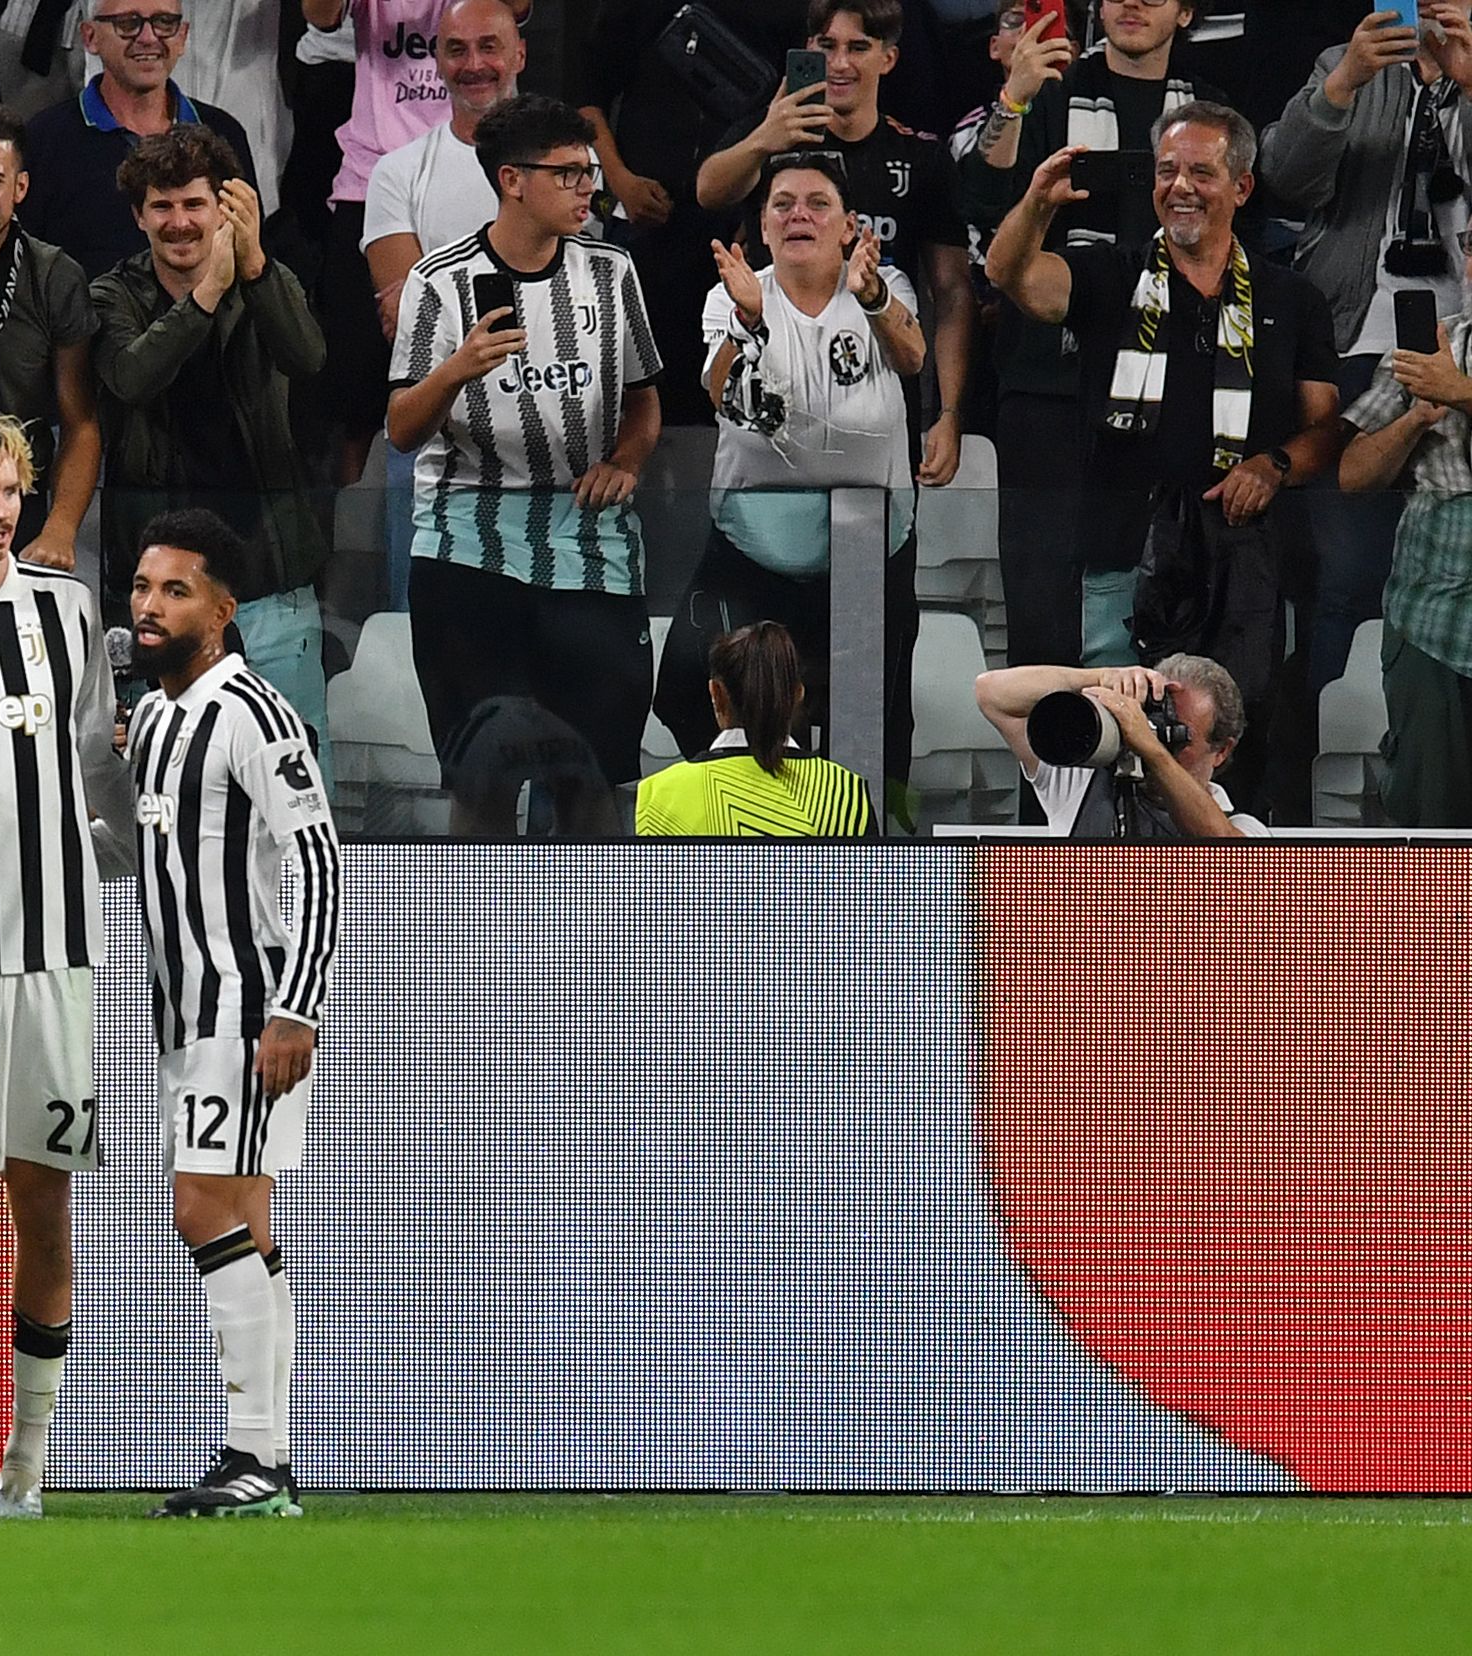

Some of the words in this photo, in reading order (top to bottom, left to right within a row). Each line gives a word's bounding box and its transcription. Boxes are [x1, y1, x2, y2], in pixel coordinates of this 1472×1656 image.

[383, 22, 438, 60] Je
[395, 81, 448, 104] Detro
[498, 353, 594, 399] Jeep
[46, 1099, 95, 1155] 27
[184, 1094, 230, 1151] 12
